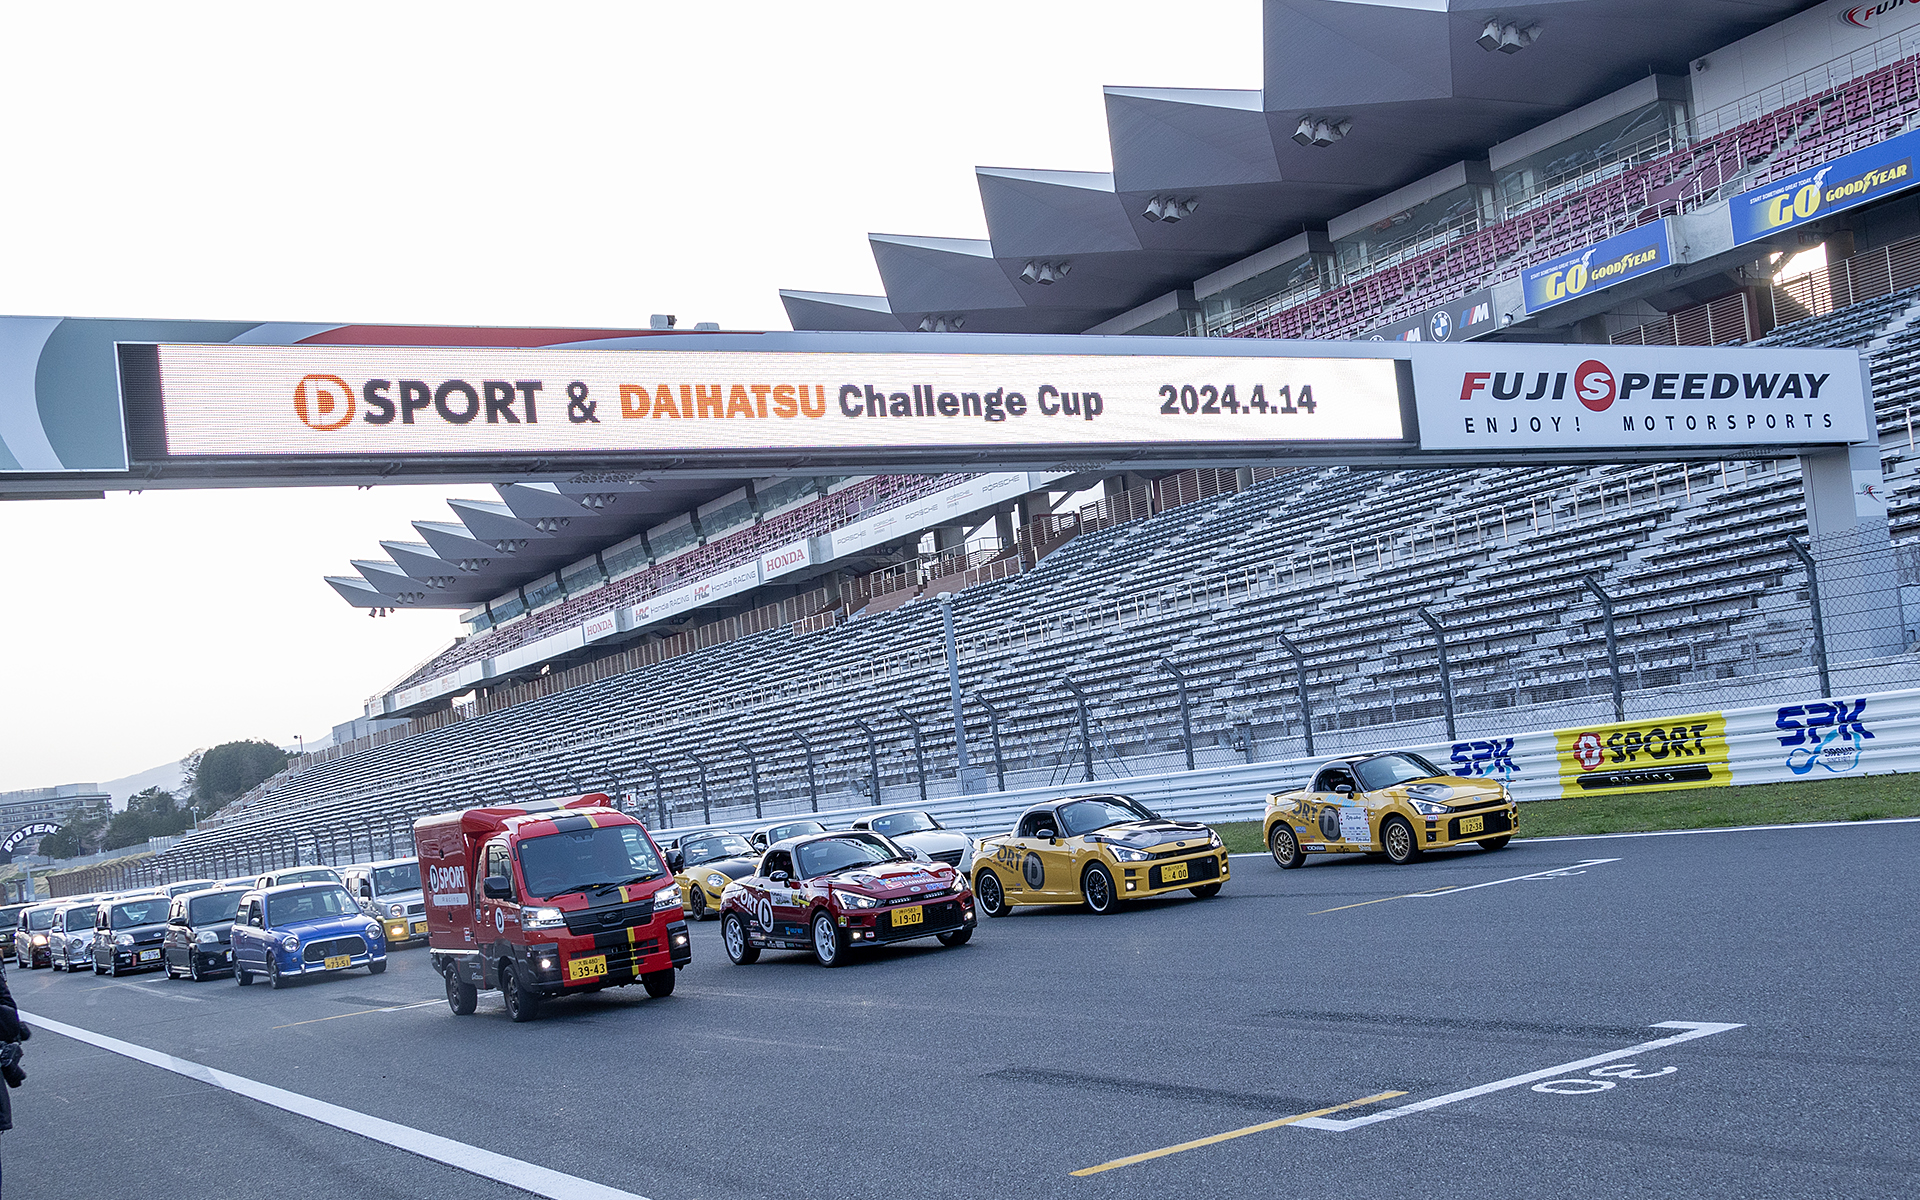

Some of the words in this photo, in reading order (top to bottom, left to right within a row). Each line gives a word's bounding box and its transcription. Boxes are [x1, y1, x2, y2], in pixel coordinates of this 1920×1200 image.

[1825, 164, 1908, 202] GOODYEAR
[1768, 184, 1821, 226] GO
[1591, 249, 1656, 281] GOODYEAR
[1546, 264, 1588, 300] GO
[1459, 372, 1569, 400] FUJI
[1577, 368, 1830, 402] SPEEDWAY
[362, 379, 543, 425] SPORT
[566, 381, 599, 424] &
[619, 384, 827, 419] DAIHATSU
[838, 384, 1028, 422] Challenge
[1036, 384, 1104, 421] Cup
[1158, 384, 1317, 415] 2024.4.14
[1464, 415, 1582, 434] ENJOY!
[1622, 413, 1832, 432] MOTORSPORTS
[982, 474, 1020, 493] PORSCHE
[904, 504, 938, 521] PORSCHE
[836, 530, 866, 545] PORSCHE
[766, 548, 806, 572] HONDA
[711, 579, 732, 593] Honda
[732, 570, 756, 586] RACING
[650, 602, 670, 614] Honda
[669, 593, 690, 608] RACING
[586, 618, 614, 636] HONDA
[1776, 698, 1876, 746] SPK
[1606, 724, 1708, 763] SPORT
[1450, 738, 1521, 776] SPK
[1610, 771, 1675, 783] Racing
[4, 824, 62, 853] POTEN
[1466, 822, 1482, 832] 12-38
[438, 866, 466, 889] SPORT
[900, 913, 921, 924] 19-07
[578, 964, 605, 978] 39-43
